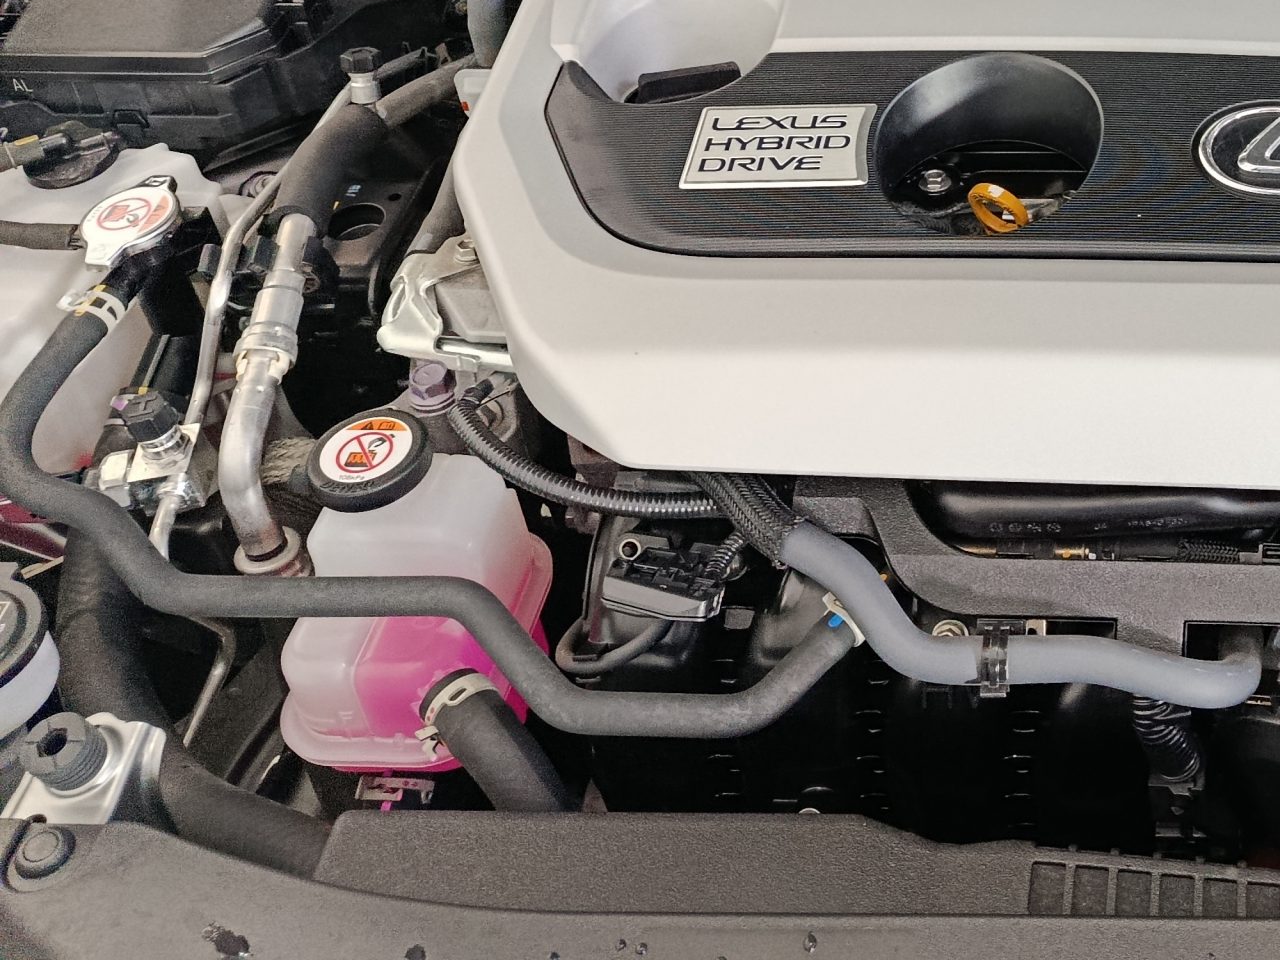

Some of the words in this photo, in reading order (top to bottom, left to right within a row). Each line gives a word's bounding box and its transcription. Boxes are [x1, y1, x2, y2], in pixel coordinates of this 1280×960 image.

[712, 115, 848, 131] LEXUS
[704, 135, 850, 152] HYBRID
[698, 156, 823, 172] DRIVE
